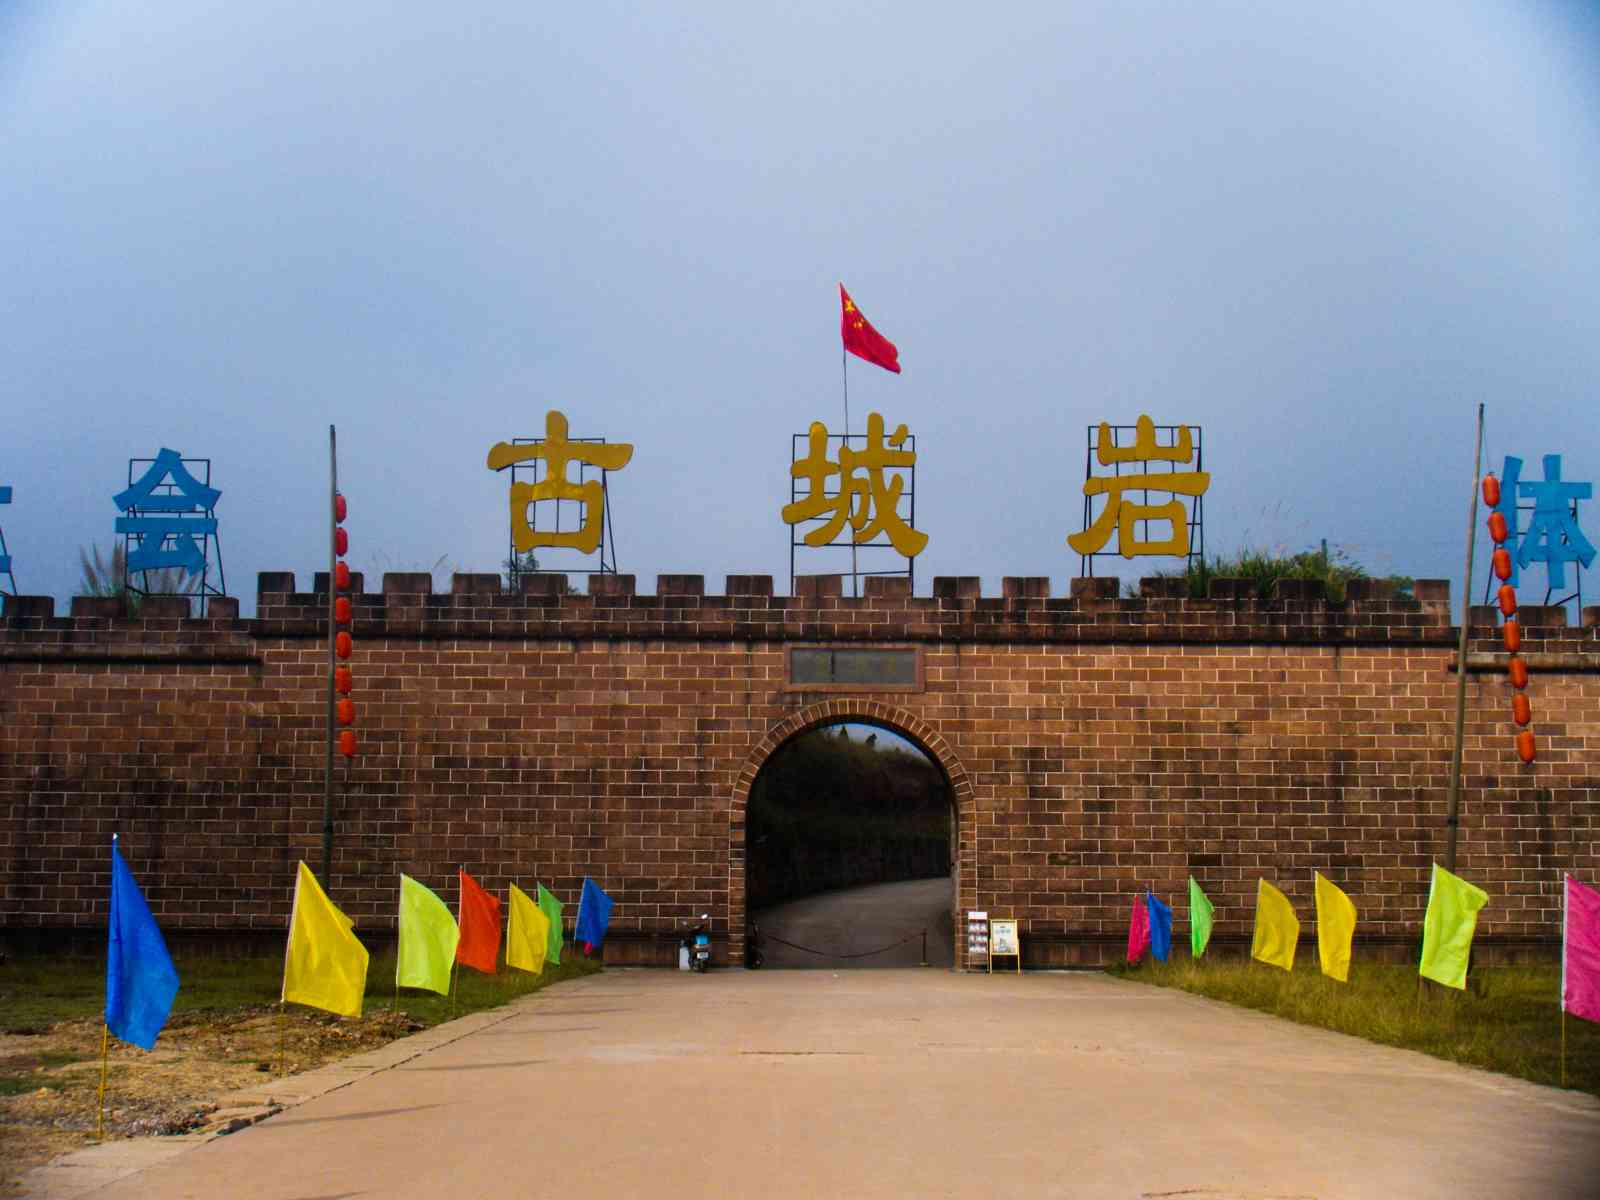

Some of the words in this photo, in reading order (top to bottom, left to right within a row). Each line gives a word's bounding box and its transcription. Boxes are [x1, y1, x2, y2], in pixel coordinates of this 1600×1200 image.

[113, 447, 222, 576] 会
[487, 410, 1211, 559] 古城岩
[1496, 454, 1597, 589] 体
